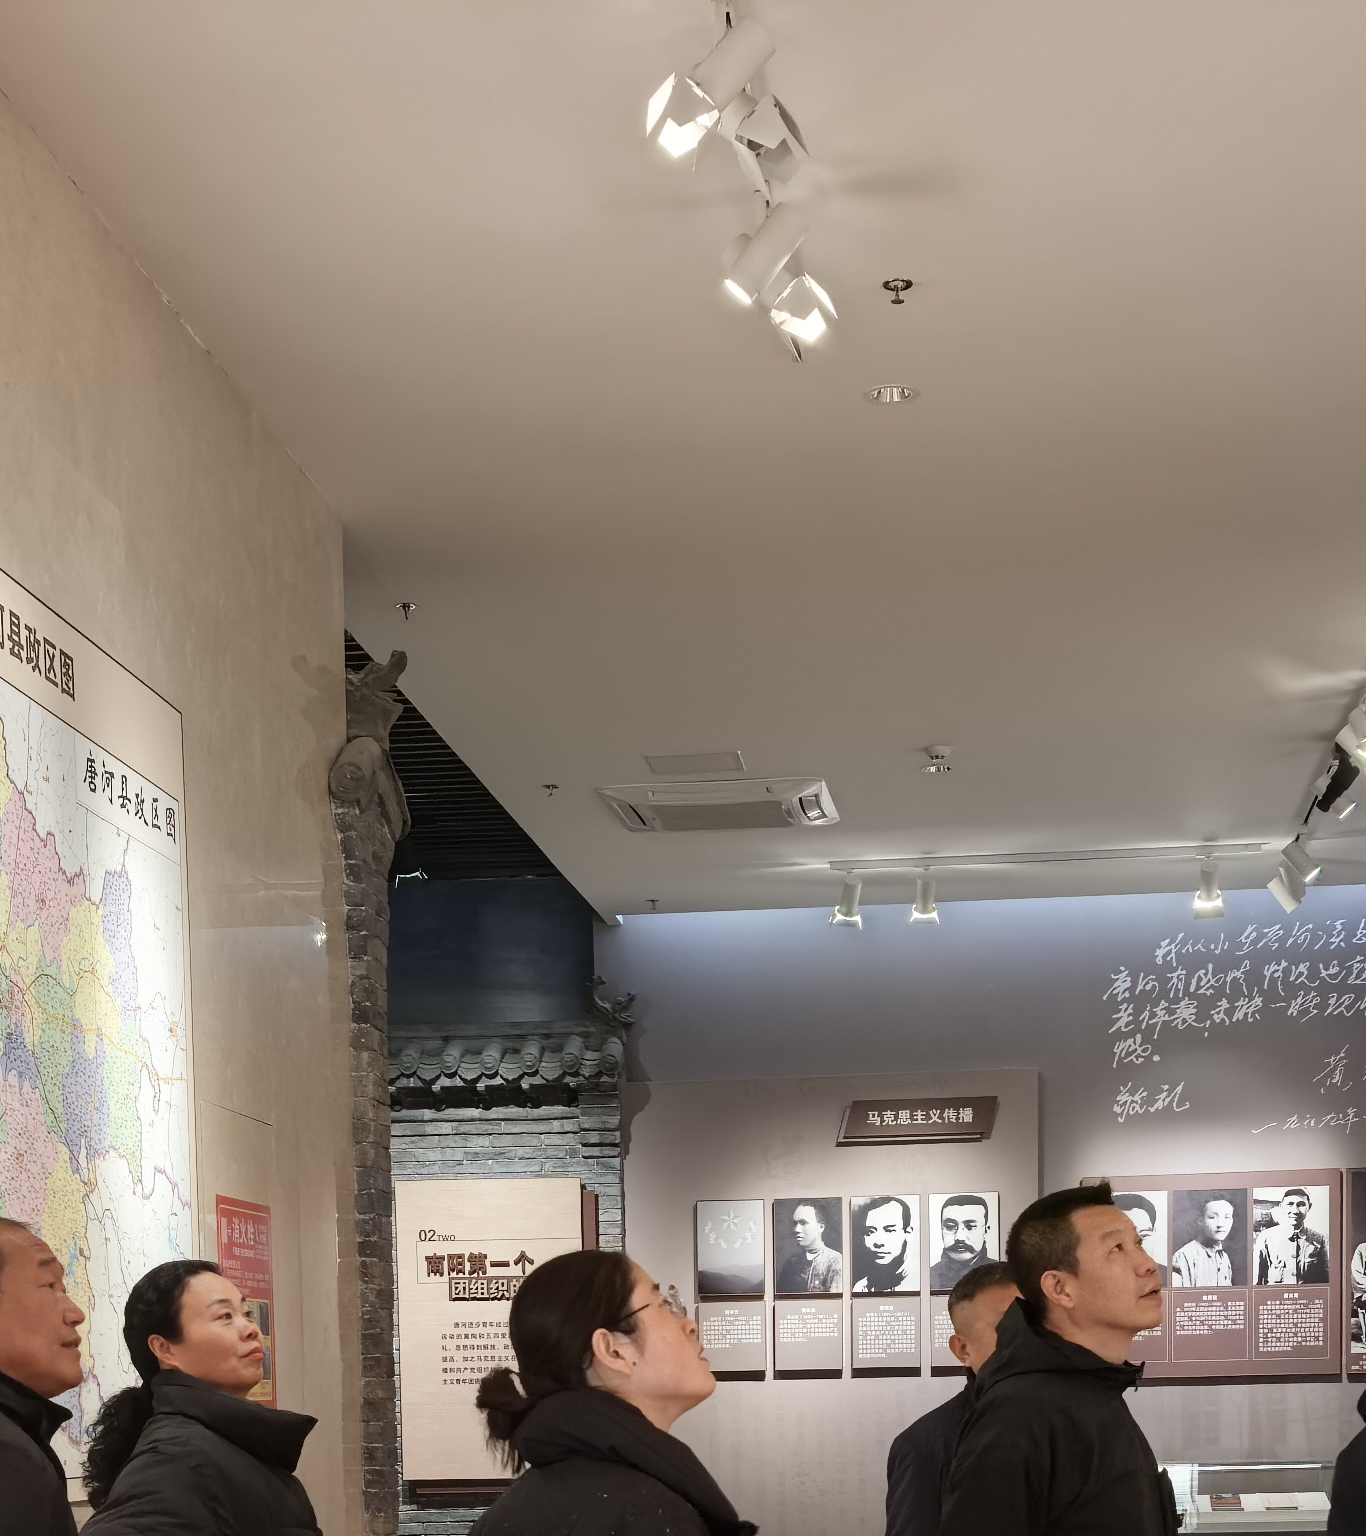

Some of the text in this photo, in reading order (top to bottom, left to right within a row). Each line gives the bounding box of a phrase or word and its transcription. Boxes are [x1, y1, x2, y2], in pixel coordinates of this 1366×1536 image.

[83, 749, 177, 846] 唐河县政区图
[866, 1107, 974, 1126] 马克思主义传播
[419, 1229, 436, 1241] 02
[425, 1250, 535, 1278] 南阳第一个
